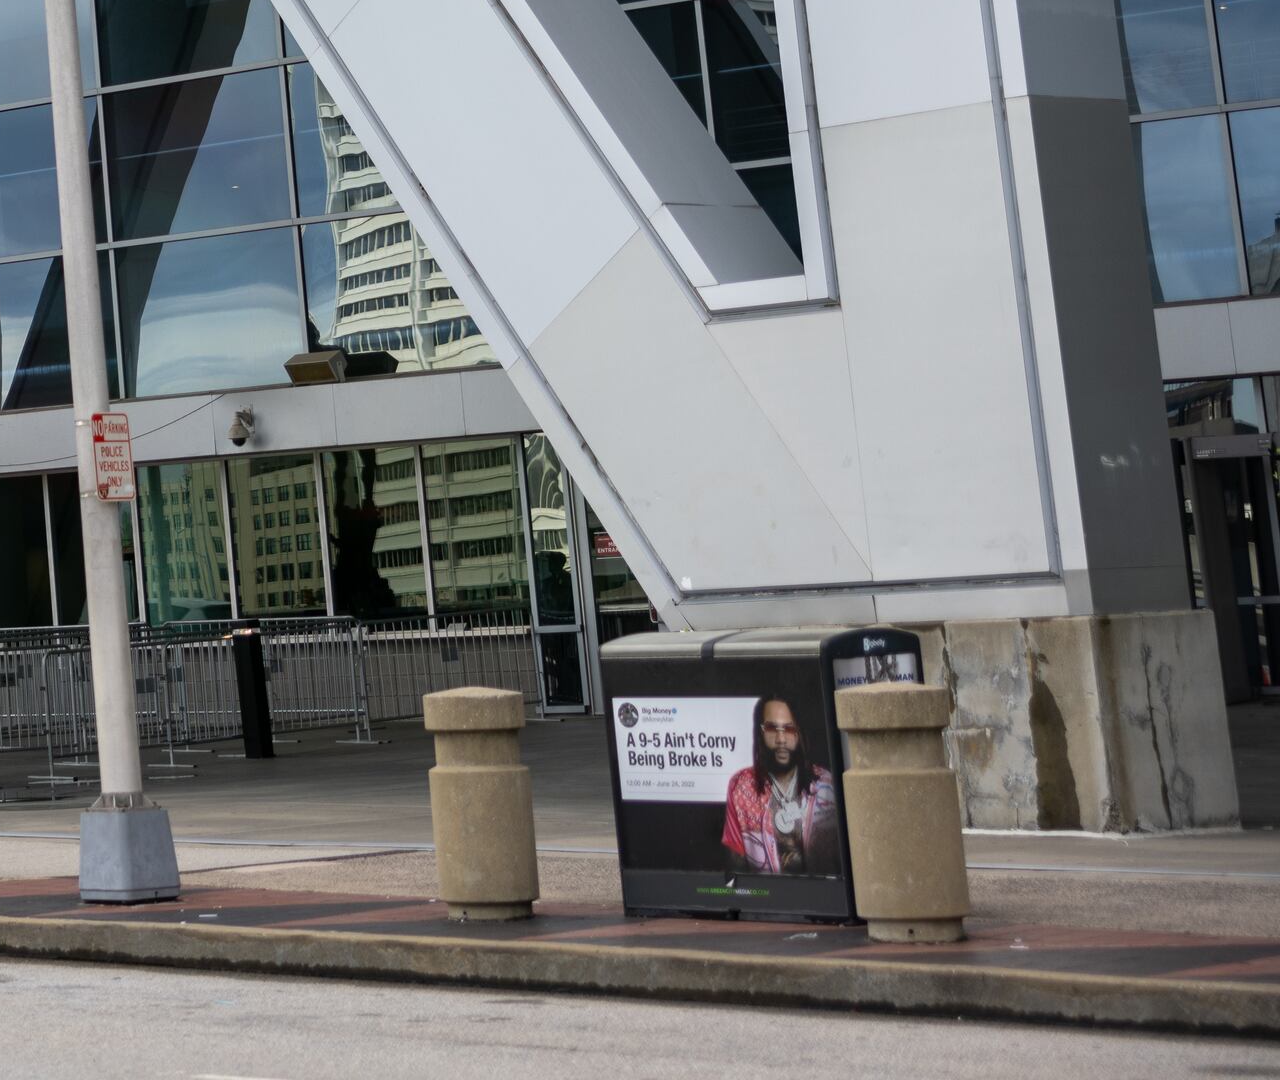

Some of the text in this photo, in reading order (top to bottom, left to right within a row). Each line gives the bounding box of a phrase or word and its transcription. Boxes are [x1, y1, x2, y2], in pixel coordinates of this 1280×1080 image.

[92, 420, 128, 436] NO PARKING
[100, 446, 123, 457] POLICE
[99, 461, 130, 472] VEHICLES
[107, 476, 122, 487] ONLY
[838, 672, 914, 686] MONEY MAN
[642, 707, 671, 715] Big Money
[626, 731, 737, 752] A 9-5 Ain't Corny
[627, 750, 724, 770] Being Broke Is
